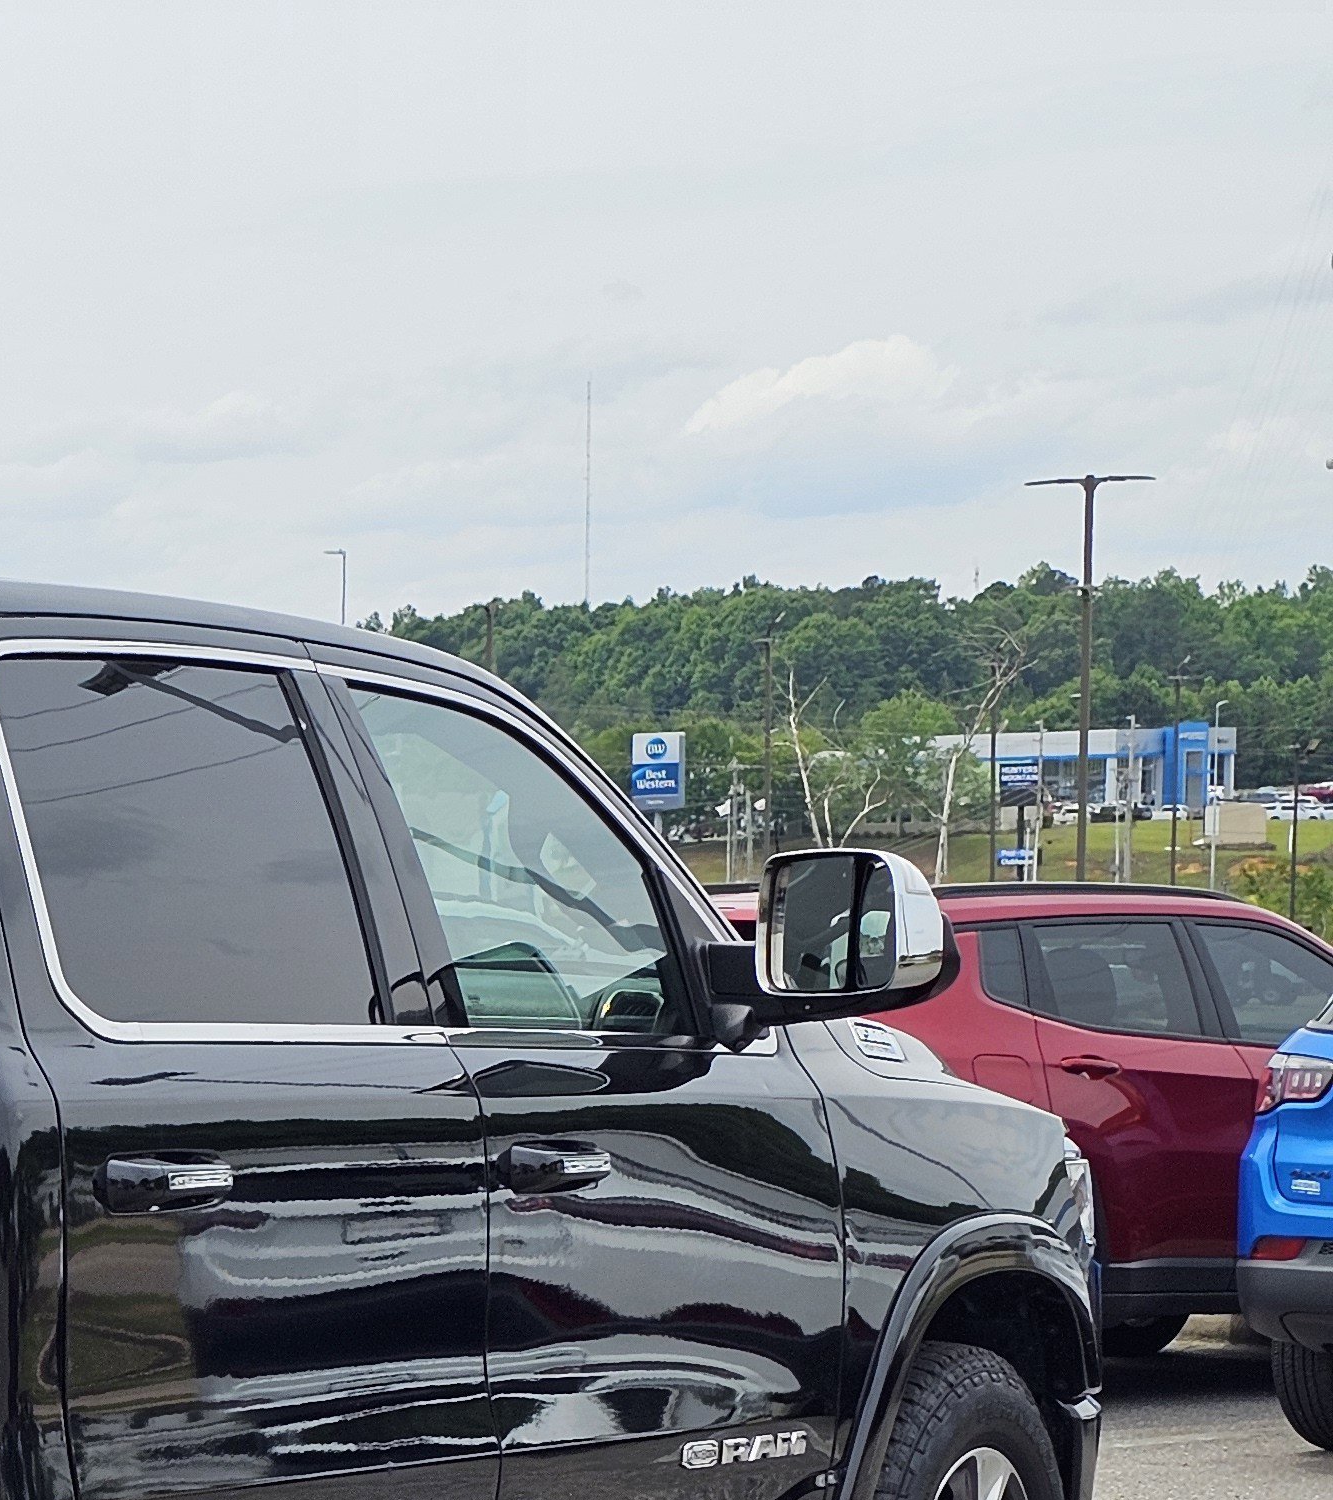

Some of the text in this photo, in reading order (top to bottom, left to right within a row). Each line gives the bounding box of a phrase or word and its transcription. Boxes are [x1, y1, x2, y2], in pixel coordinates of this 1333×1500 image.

[646, 770, 666, 779] Best
[637, 780, 676, 789] Western
[721, 1430, 808, 1465] RAM
